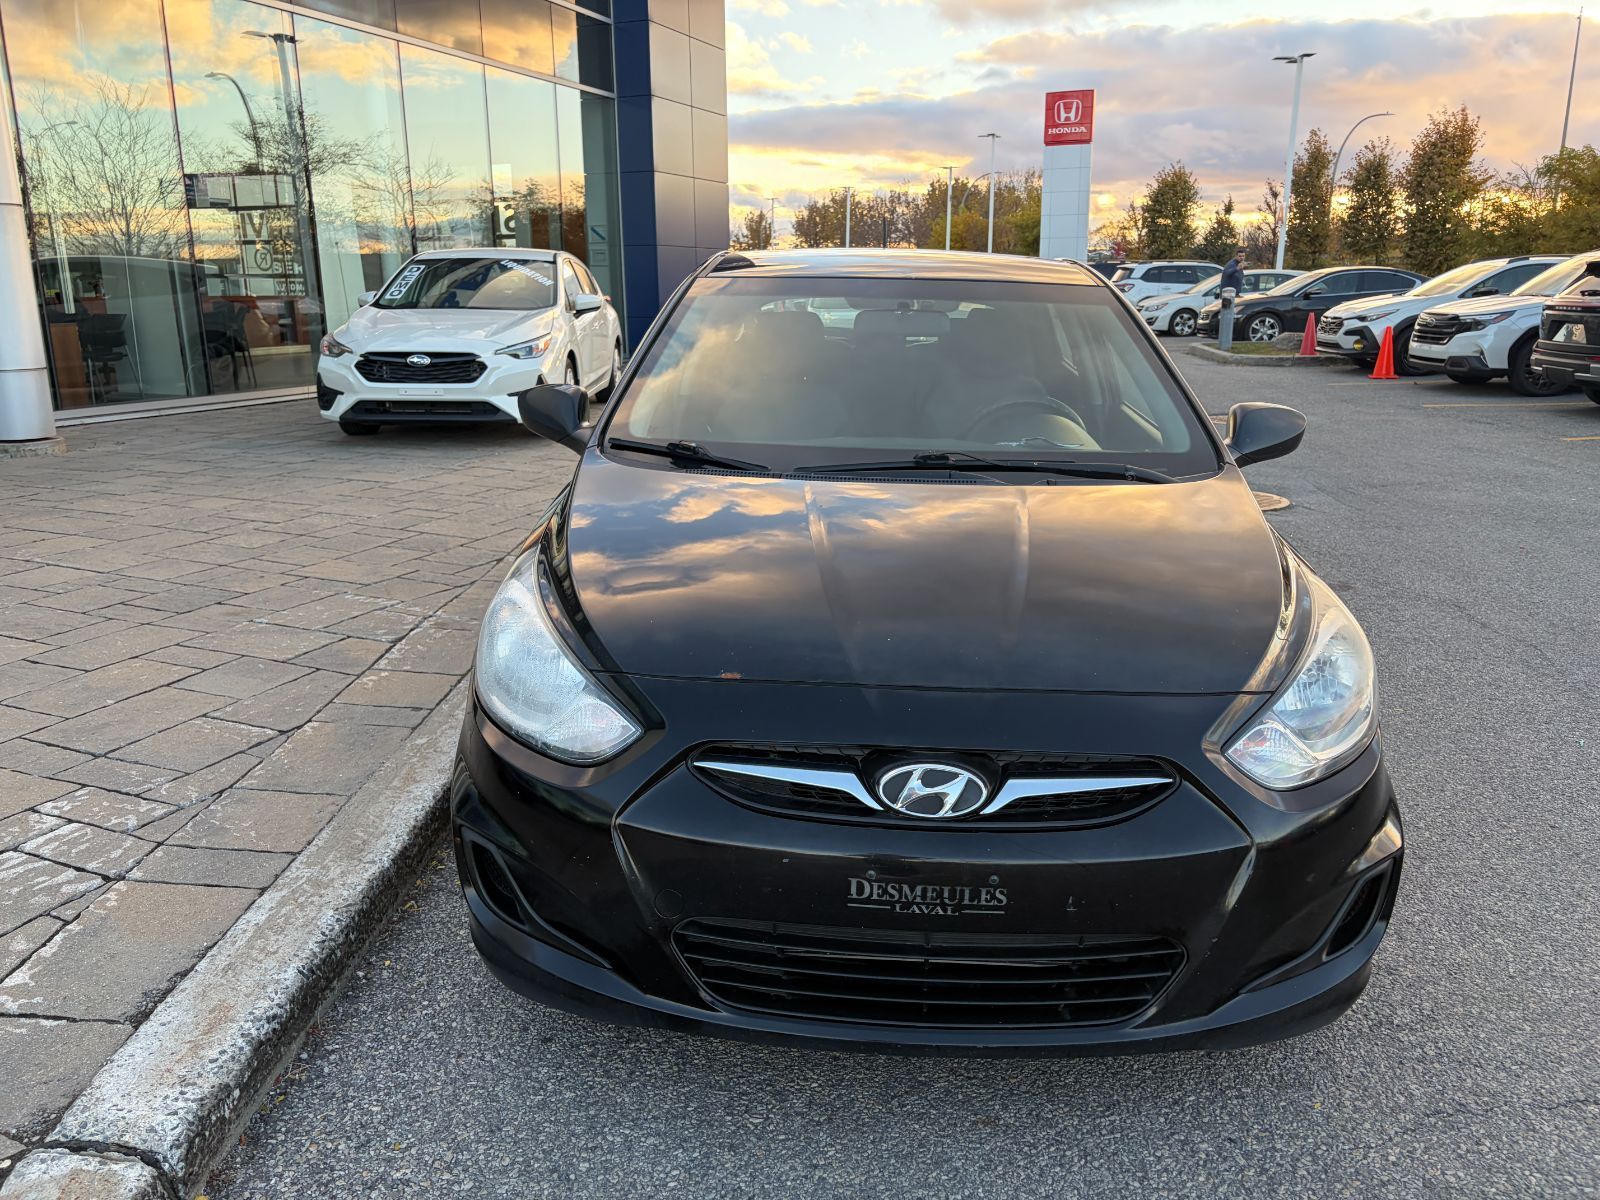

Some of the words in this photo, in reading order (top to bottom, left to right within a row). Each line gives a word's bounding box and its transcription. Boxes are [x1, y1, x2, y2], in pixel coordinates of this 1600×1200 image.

[1048, 126, 1088, 135] HONDA
[389, 266, 422, 297] DEMO
[848, 877, 1008, 906] DESMEULES
[894, 903, 959, 916] LAVAL
